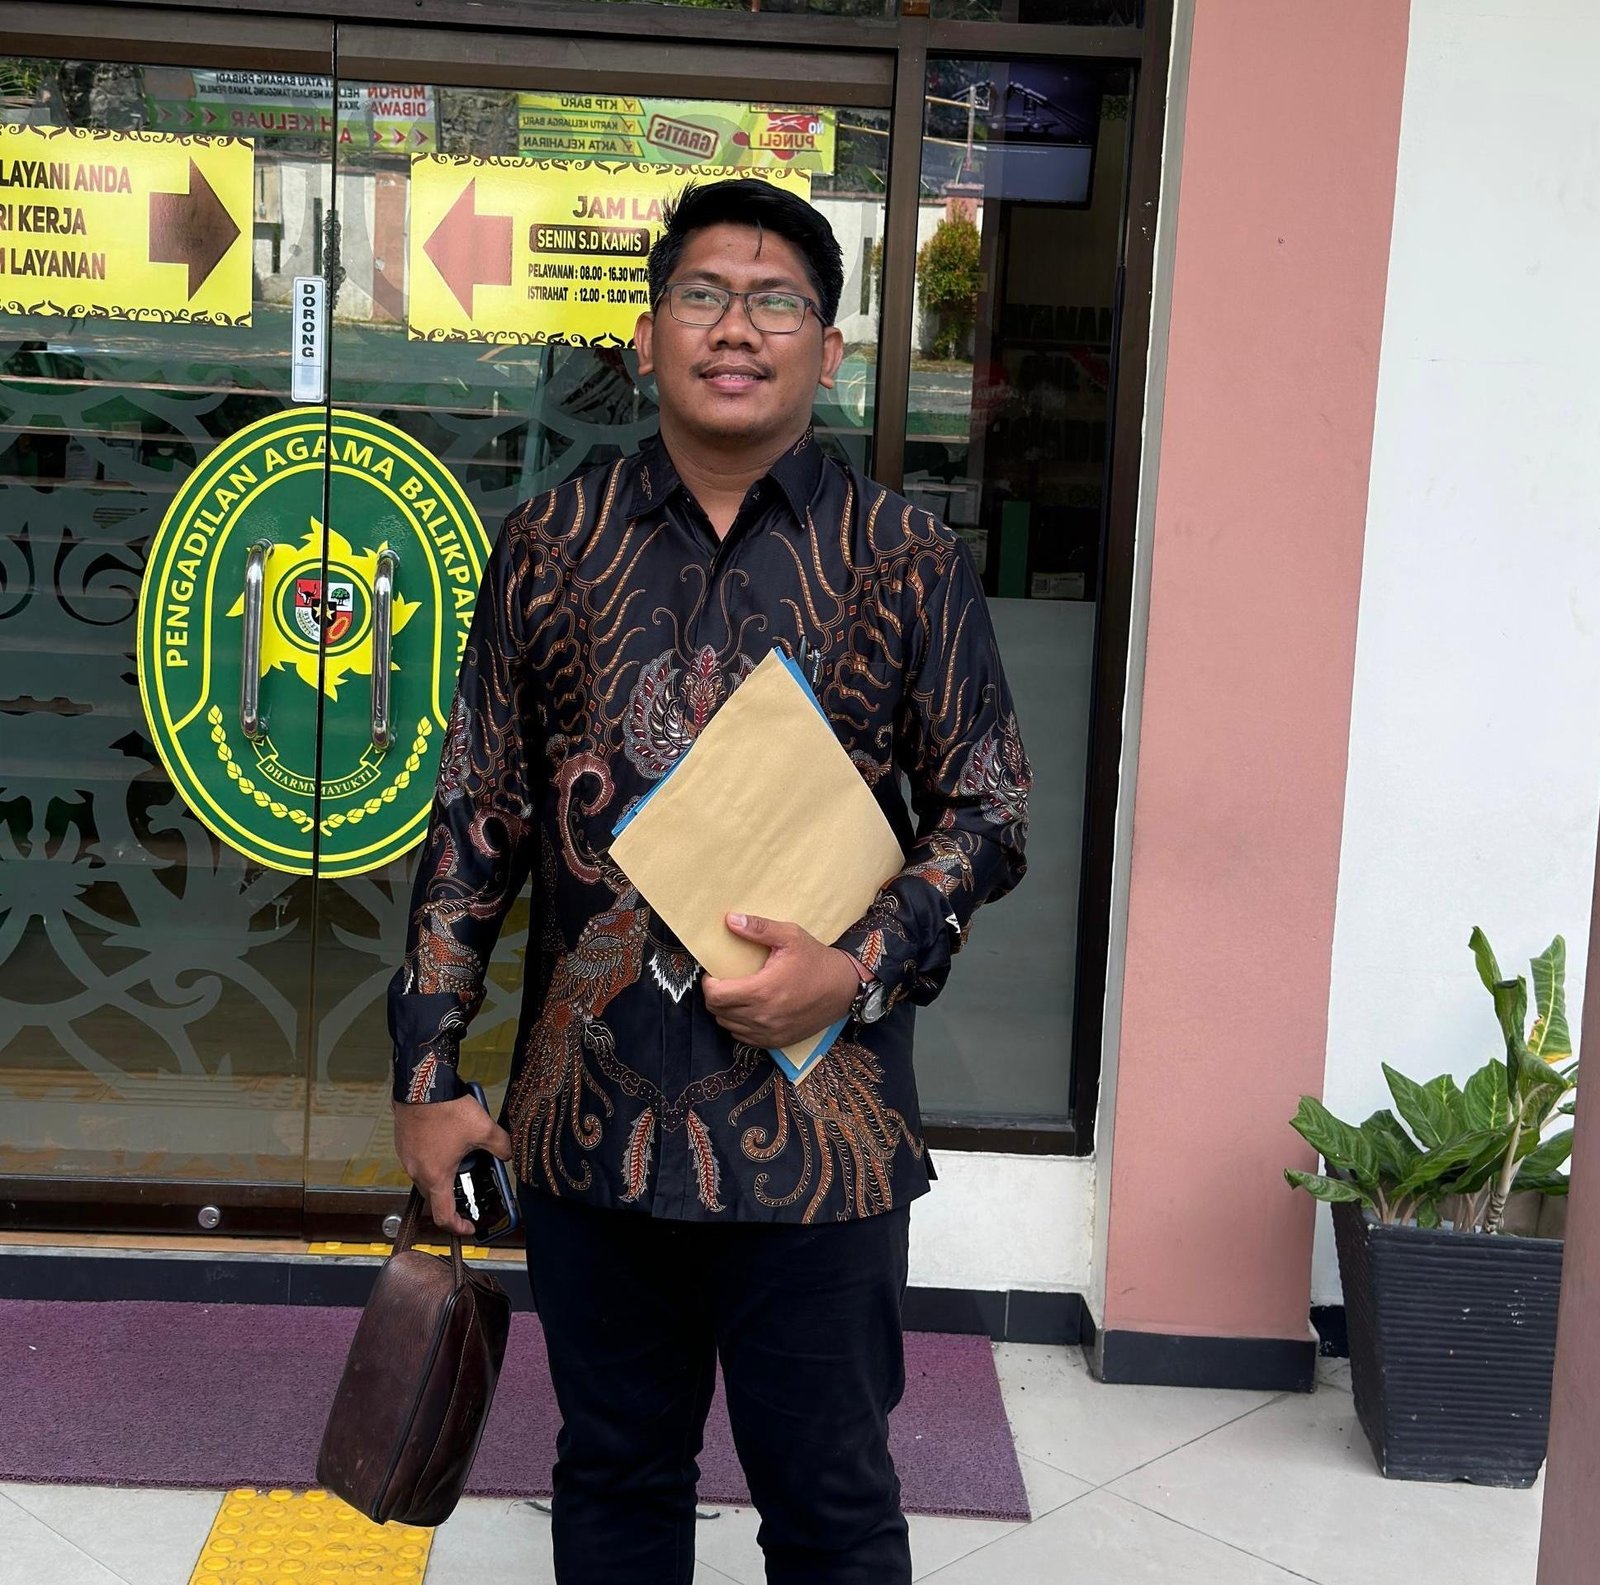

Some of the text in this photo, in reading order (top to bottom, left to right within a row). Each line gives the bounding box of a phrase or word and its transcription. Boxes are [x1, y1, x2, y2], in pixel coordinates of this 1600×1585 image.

[74, 164, 132, 194] ANDA
[18, 204, 87, 236] KERJA
[572, 196, 625, 220] JAM
[537, 228, 576, 249] SENIN
[578, 230, 598, 251] S.D
[601, 232, 642, 252] KAMIS
[11, 247, 106, 280] LAYANAN
[528, 263, 574, 279] PELAYANAN
[580, 265, 602, 281] 08.00
[608, 267, 628, 282] 16.30
[629, 268, 649, 283] WITA
[527, 286, 569, 301] ISTIRAHAT
[579, 288, 599, 302] 12.00
[607, 288, 626, 303] 13.00
[629, 290, 648, 304] WITA
[302, 284, 316, 358] DORONG
[166, 434, 476, 677] PENGADILAN AGAMA BALIKPAPA
